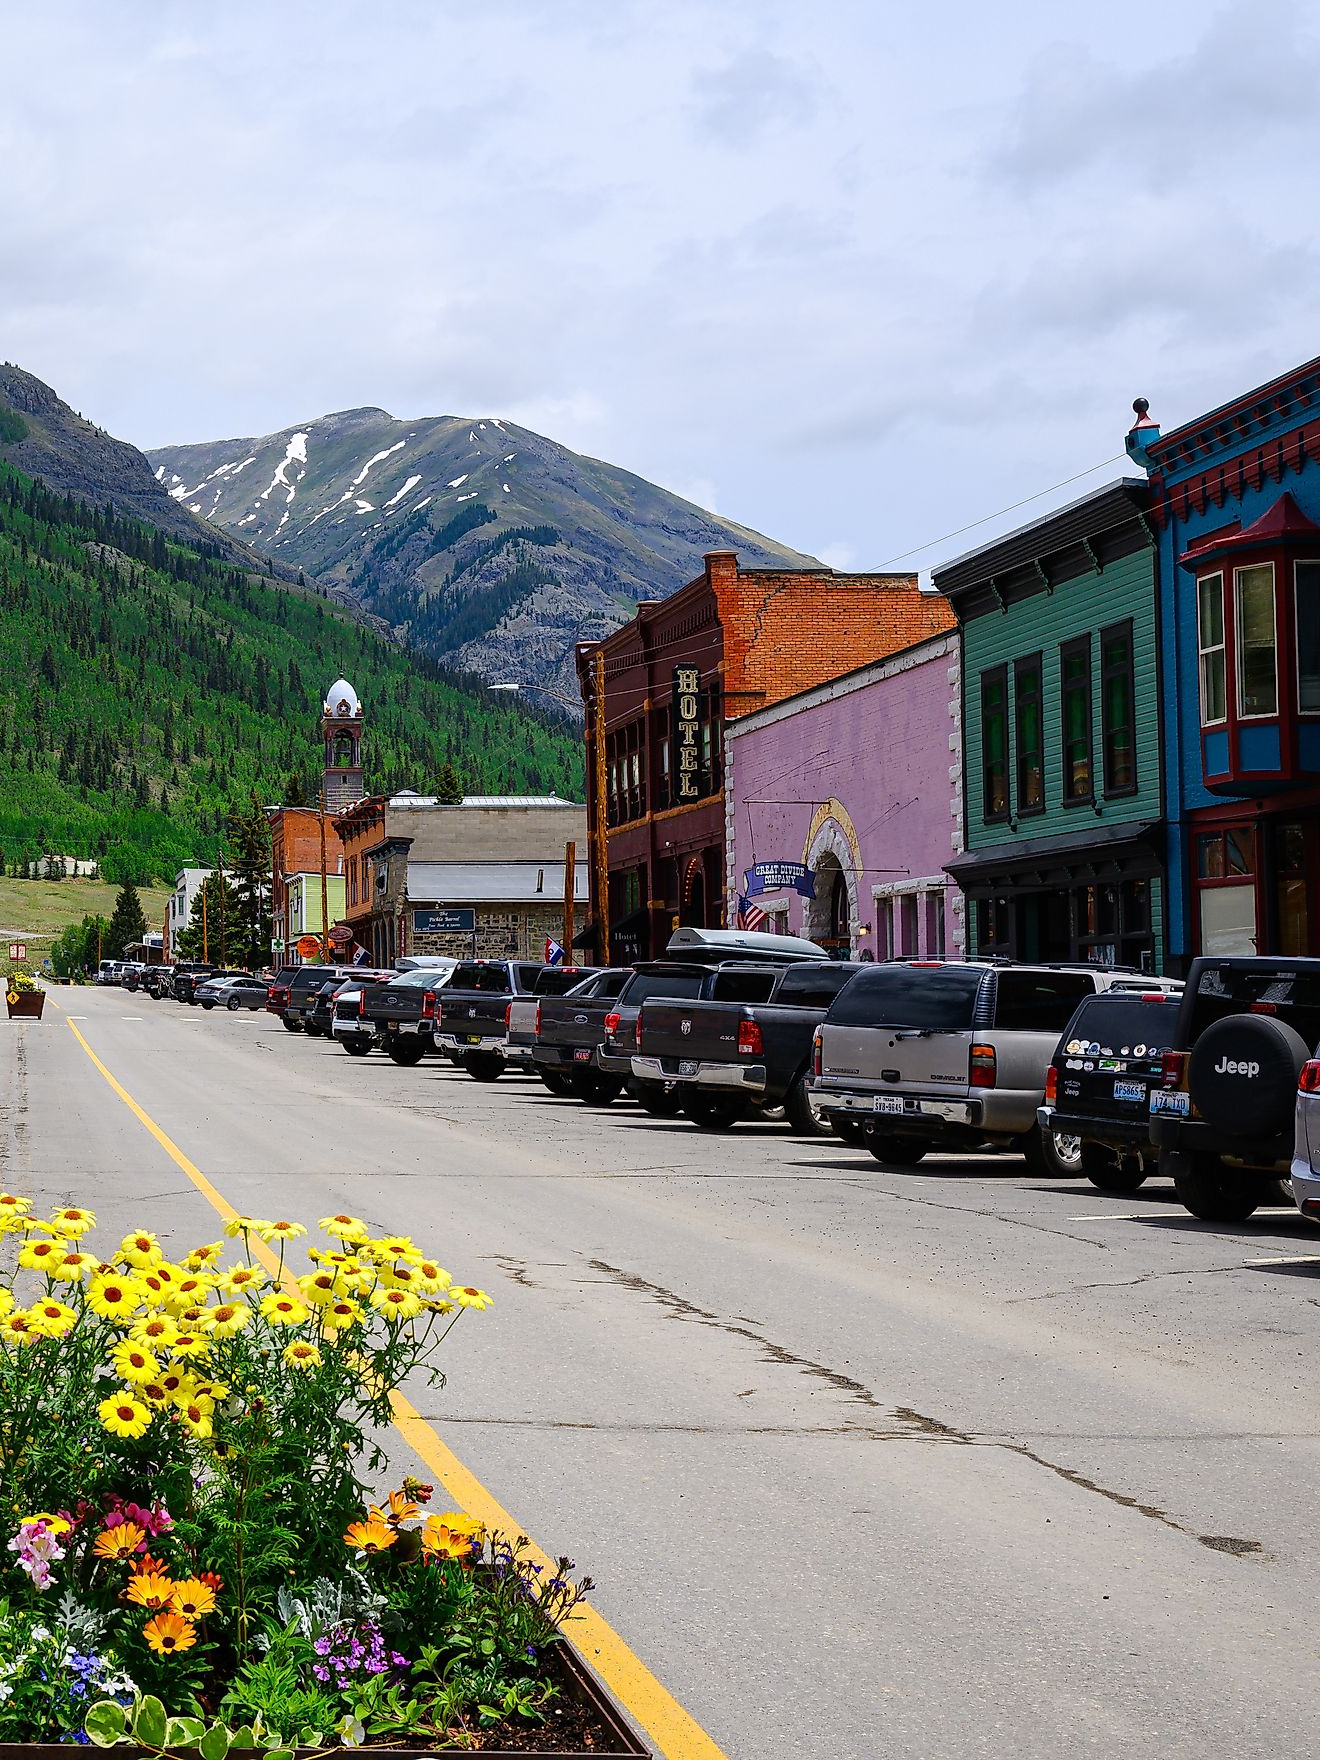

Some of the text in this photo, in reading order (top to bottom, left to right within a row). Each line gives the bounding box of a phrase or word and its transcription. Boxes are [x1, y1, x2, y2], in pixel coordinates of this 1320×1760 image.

[677, 670, 699, 796] HOTEL
[755, 864, 805, 876] GREAT DIVIDE
[764, 875, 796, 885] COMPANY
[615, 932, 637, 940] Hotel
[1214, 1056, 1260, 1078] Jeep
[1064, 1088, 1080, 1097] Jeep
